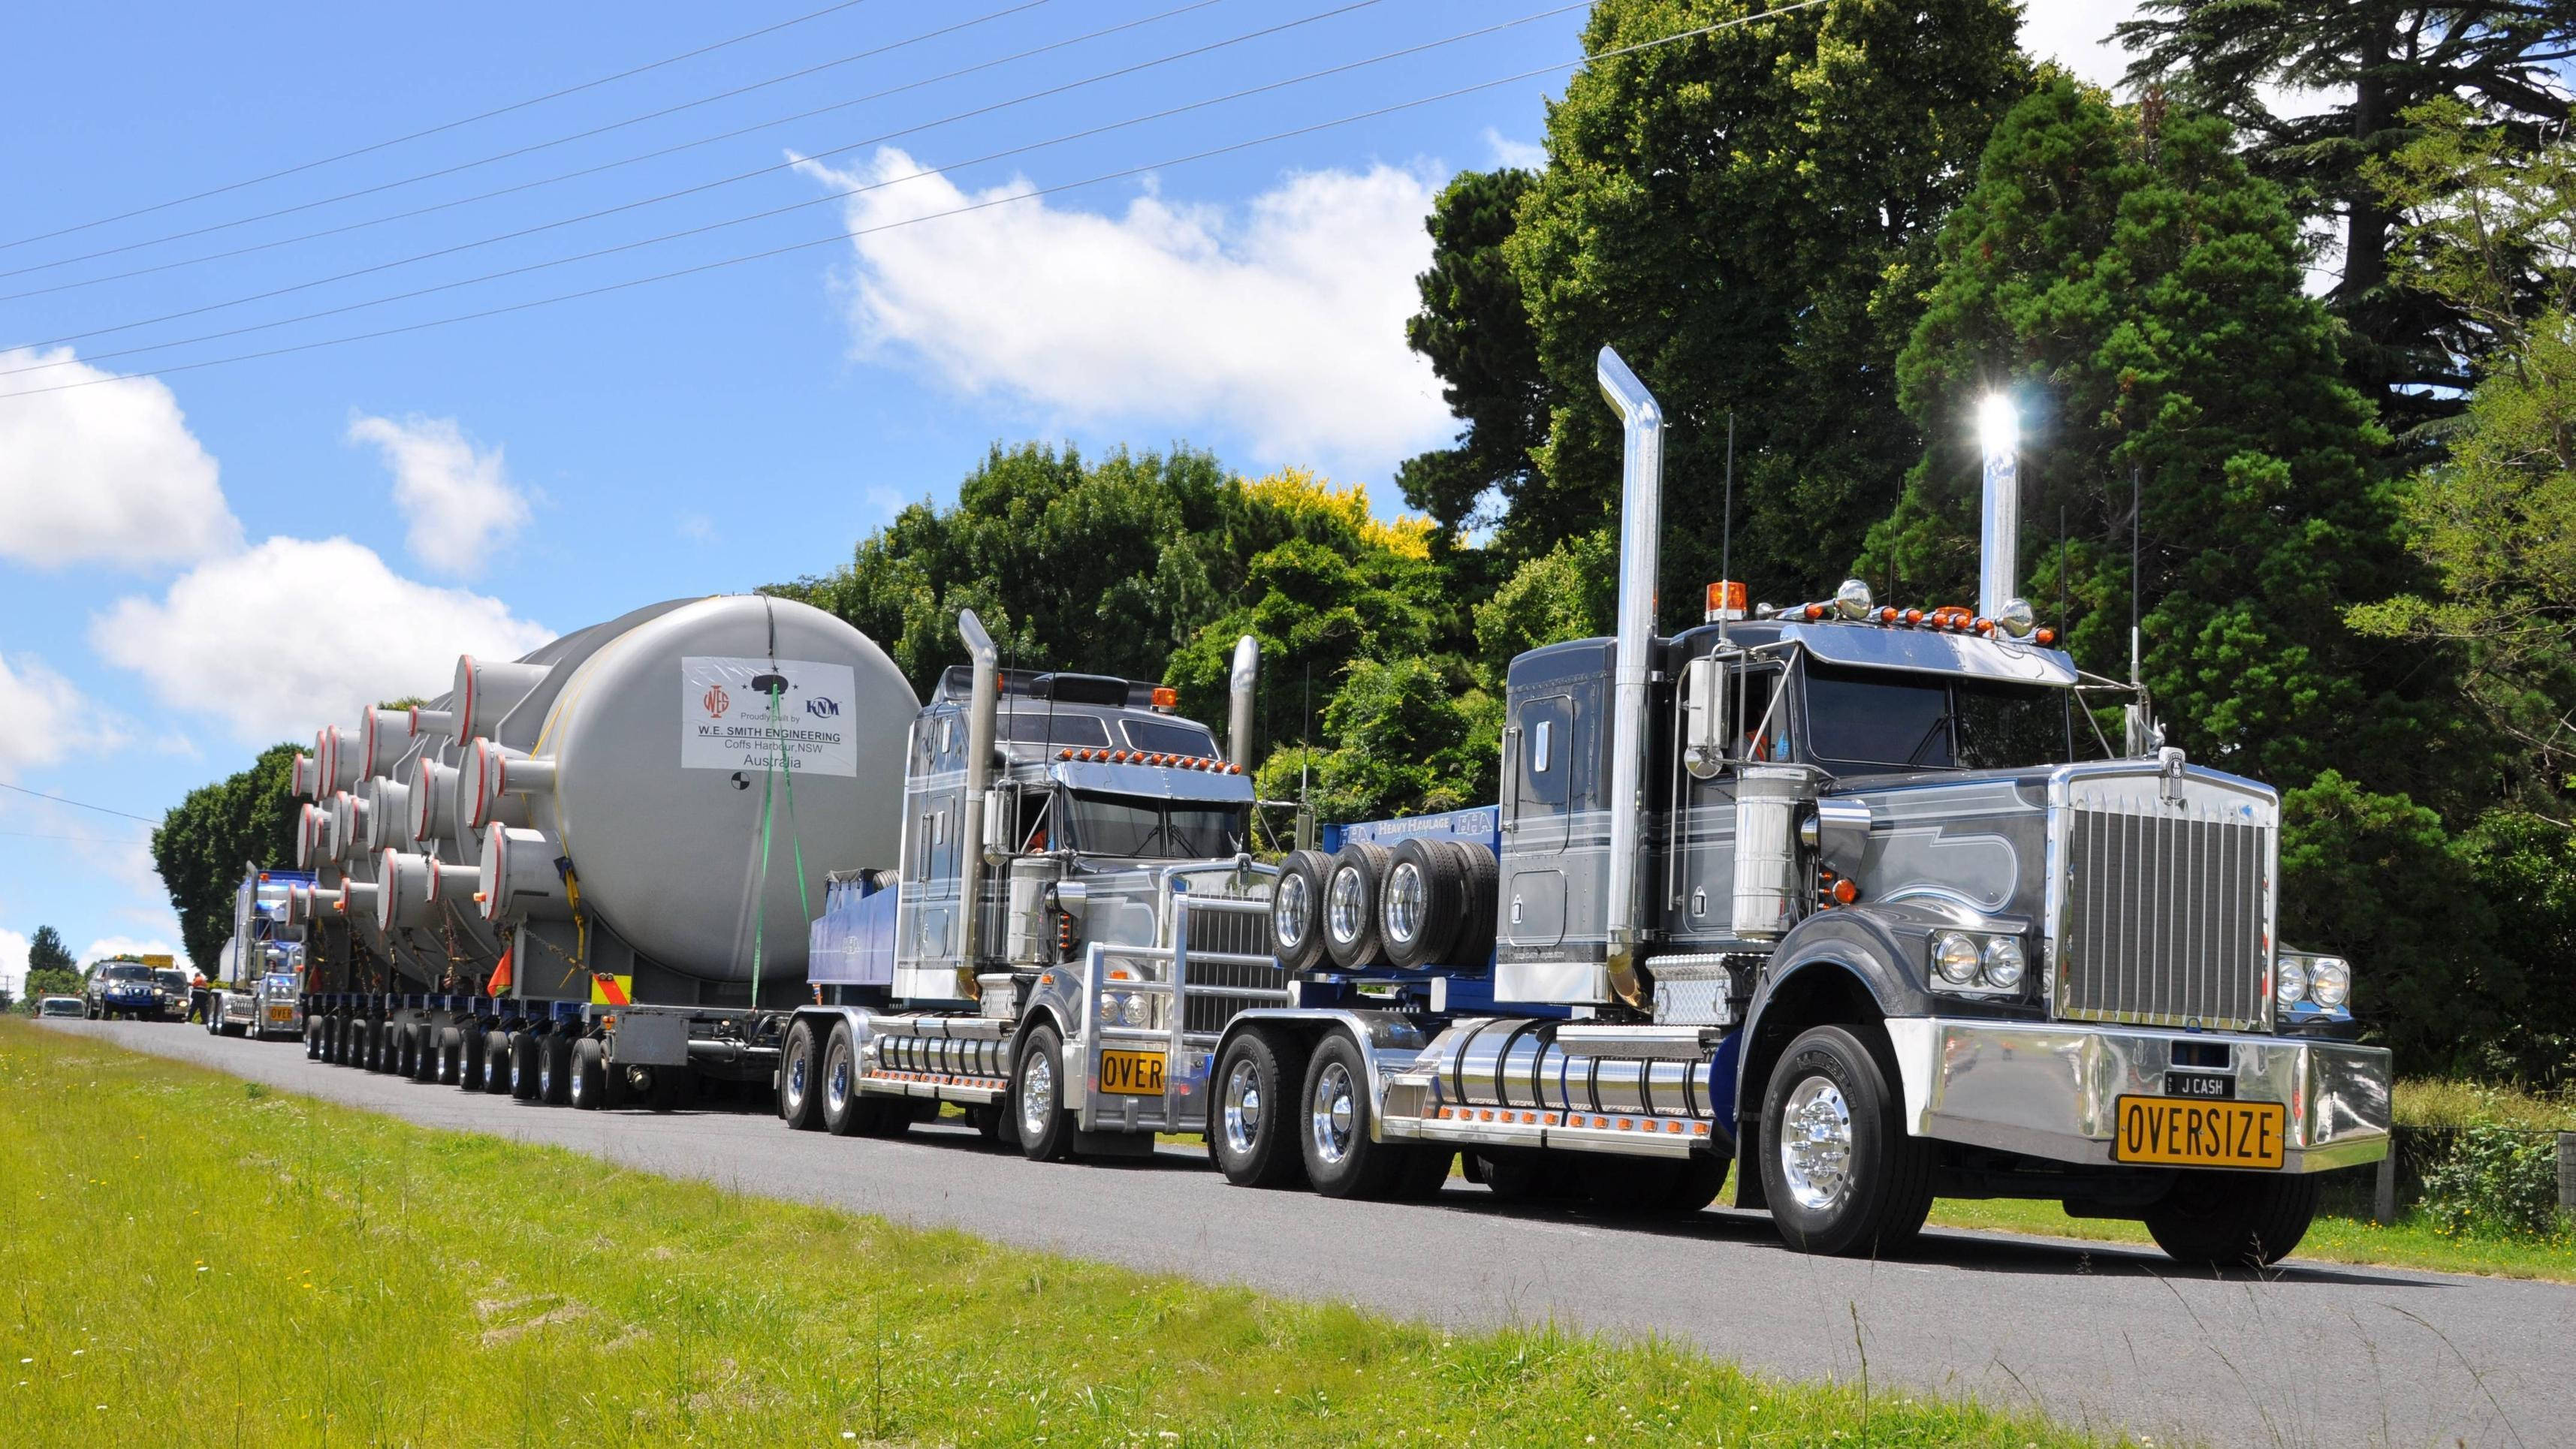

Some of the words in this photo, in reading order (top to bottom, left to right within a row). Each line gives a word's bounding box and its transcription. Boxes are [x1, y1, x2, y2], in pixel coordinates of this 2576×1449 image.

[806, 698, 840, 718] KNM
[741, 712, 771, 722] Proudly
[790, 715, 801, 724] by
[698, 726, 723, 735] W.E.
[727, 727, 762, 737] SMITH
[766, 728, 841, 743] ENGINEERING
[725, 739, 752, 749] Coffs
[744, 754, 801, 768] Australia
[1378, 821, 1407, 835] HEAVY
[1408, 818, 1449, 832] HAULAGE
[271, 1008, 293, 1020] OVER
[1104, 1056, 1163, 1089] OVER
[2182, 1077, 2190, 1093] J
[2193, 1078, 2223, 1095] CASH
[2127, 1104, 2273, 1159] OVERSIZE
